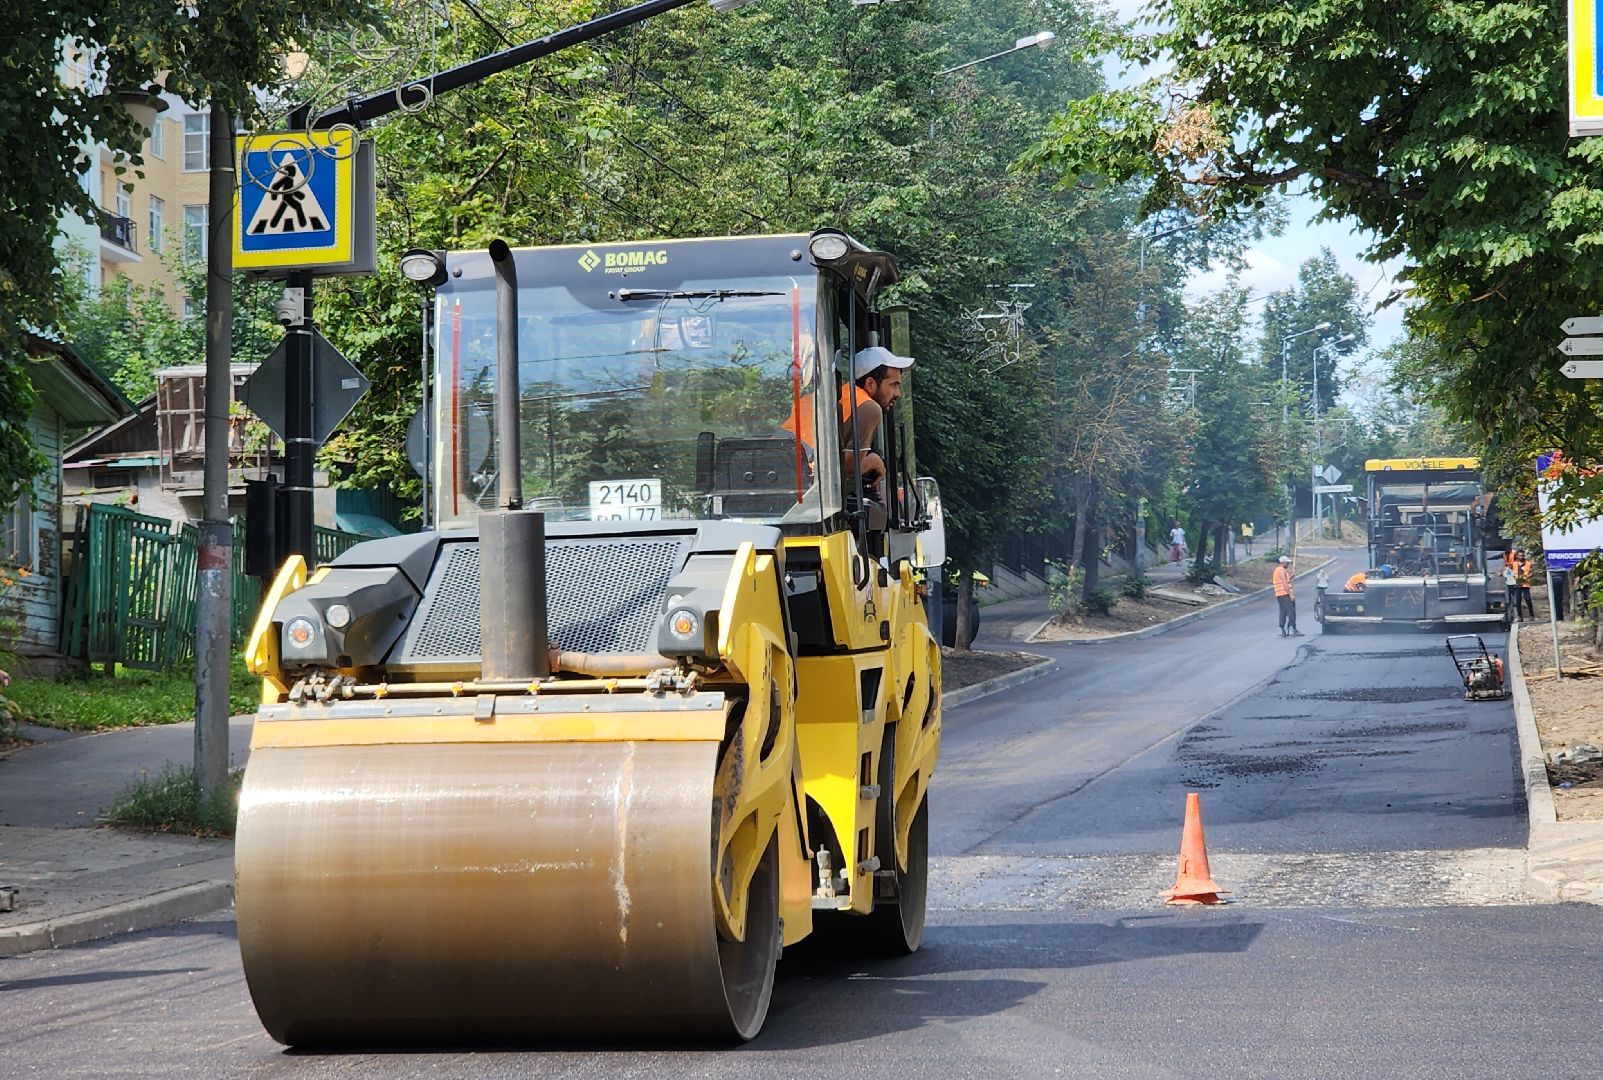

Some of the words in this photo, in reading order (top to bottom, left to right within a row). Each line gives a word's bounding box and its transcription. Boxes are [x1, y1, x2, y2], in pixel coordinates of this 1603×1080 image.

[605, 250, 668, 267] BOMAG
[599, 483, 652, 505] 2140
[636, 508, 656, 521] 77
